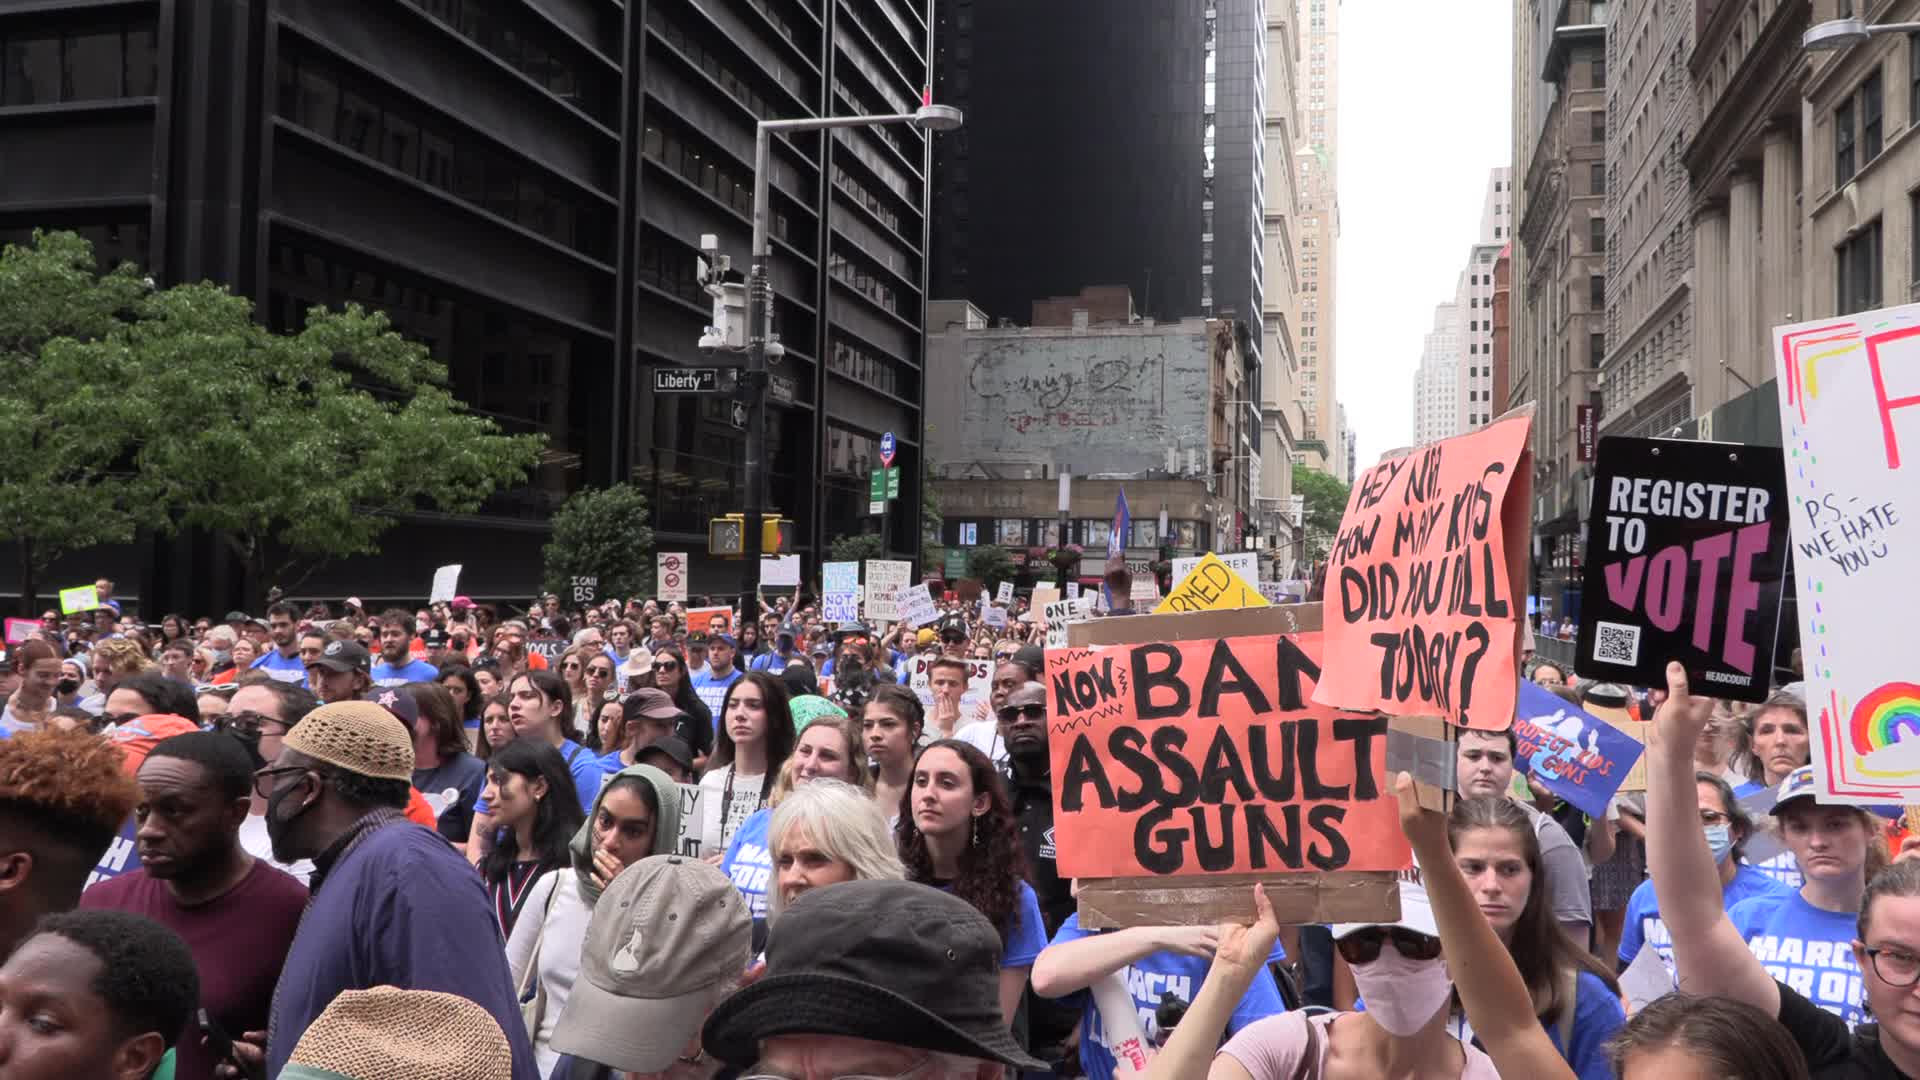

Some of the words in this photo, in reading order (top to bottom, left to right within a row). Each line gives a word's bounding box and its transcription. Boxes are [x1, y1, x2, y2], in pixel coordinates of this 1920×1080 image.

[657, 373, 701, 391] Liberty
[1355, 458, 1407, 513] HEY
[1608, 476, 1770, 524] REGISTER
[1332, 514, 1381, 566] HOW
[1606, 516, 1647, 554] TO
[1799, 531, 1837, 560] WE
[1840, 502, 1899, 539] HATE
[570, 576, 578, 586] I
[1830, 543, 1871, 577] YOU
[574, 587, 594, 602] BS
[826, 594, 853, 606] NOT
[1169, 563, 1230, 612] RMED
[1340, 562, 1399, 624] DID
[1401, 556, 1448, 618] YOU
[1603, 521, 1771, 676] VOTE
[825, 606, 856, 620] GUNS
[1045, 601, 1078, 618] ONE
[1052, 657, 1117, 716] NOW
[1130, 635, 1321, 720] BAN
[1370, 621, 1490, 726] TODAY?
[1705, 670, 1752, 686] HEADCOUNT
[1061, 718, 1388, 813] ASSAULT
[1542, 754, 1589, 785] GUNS
[1134, 804, 1351, 874] GUNS
[1749, 936, 1861, 973] MARC
